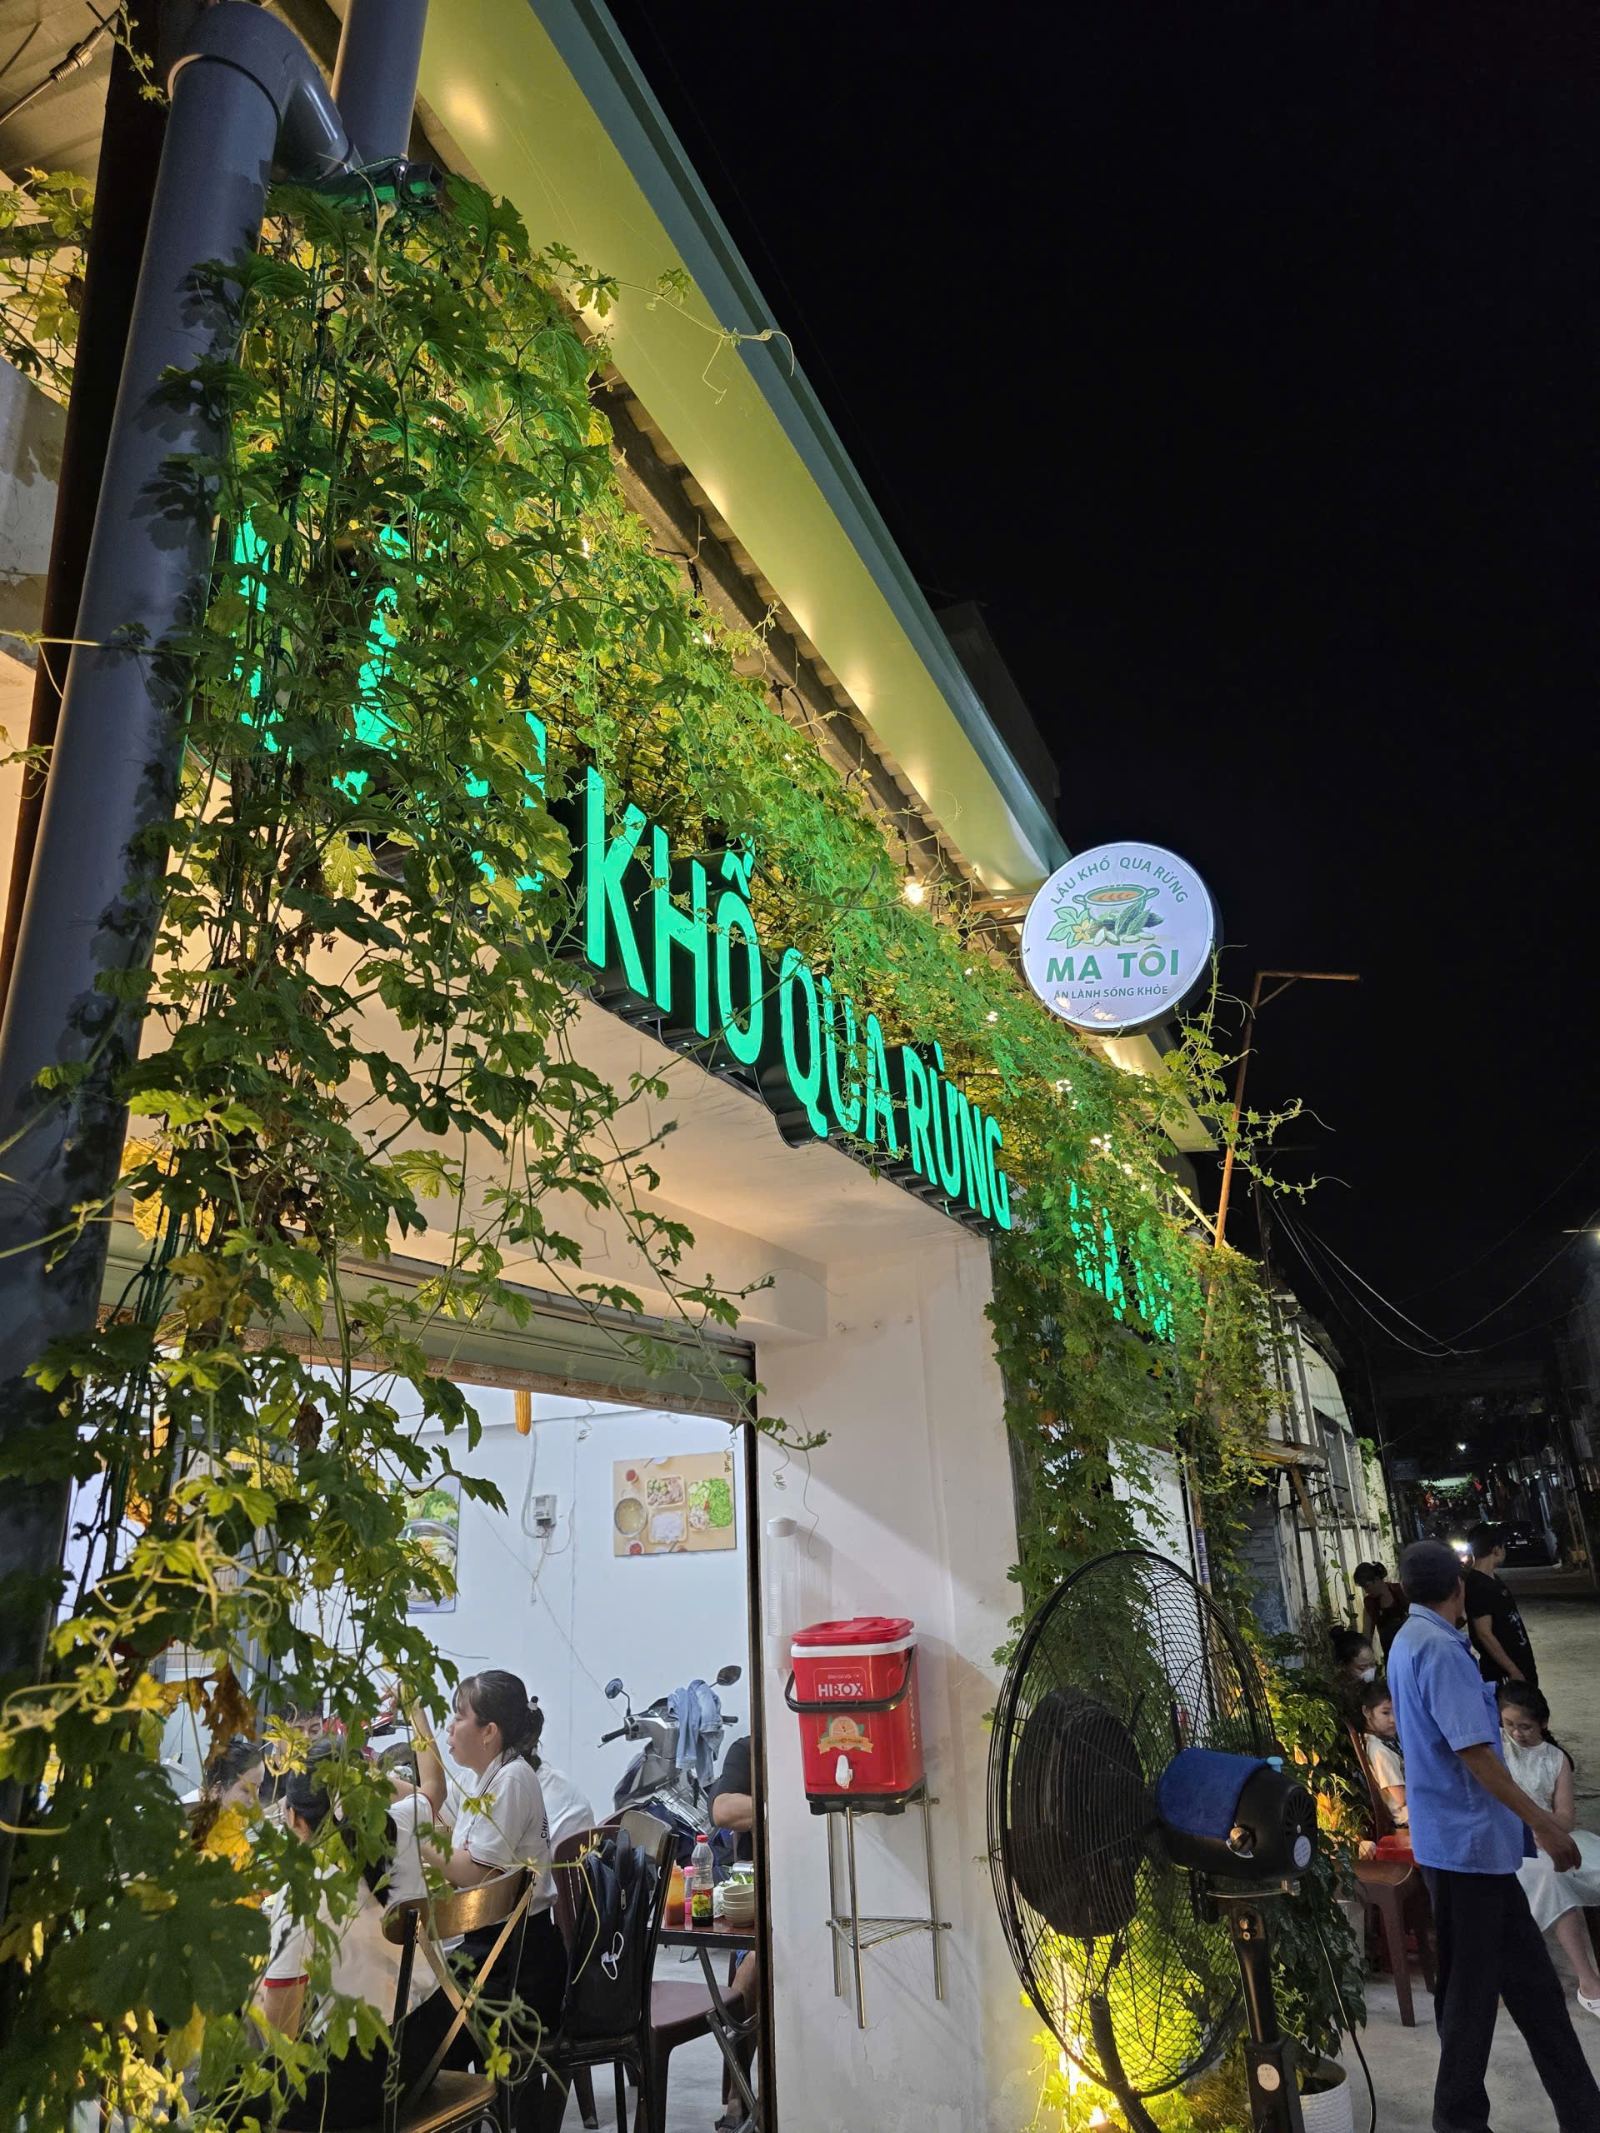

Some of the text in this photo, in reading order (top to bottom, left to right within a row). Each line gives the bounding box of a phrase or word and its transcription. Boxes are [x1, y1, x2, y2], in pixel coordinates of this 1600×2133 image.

[1119, 856, 1152, 873] QUA
[1046, 943, 1179, 984] MẠ TÔI
[586, 765, 764, 1067] KHỔ
[779, 946, 900, 1160] QUA
[902, 1039, 1013, 1230] RỪNG
[1071, 987, 1101, 1000] LÀNH
[1103, 985, 1135, 998] SỐNG
[817, 1683, 864, 1697] HIBOX
